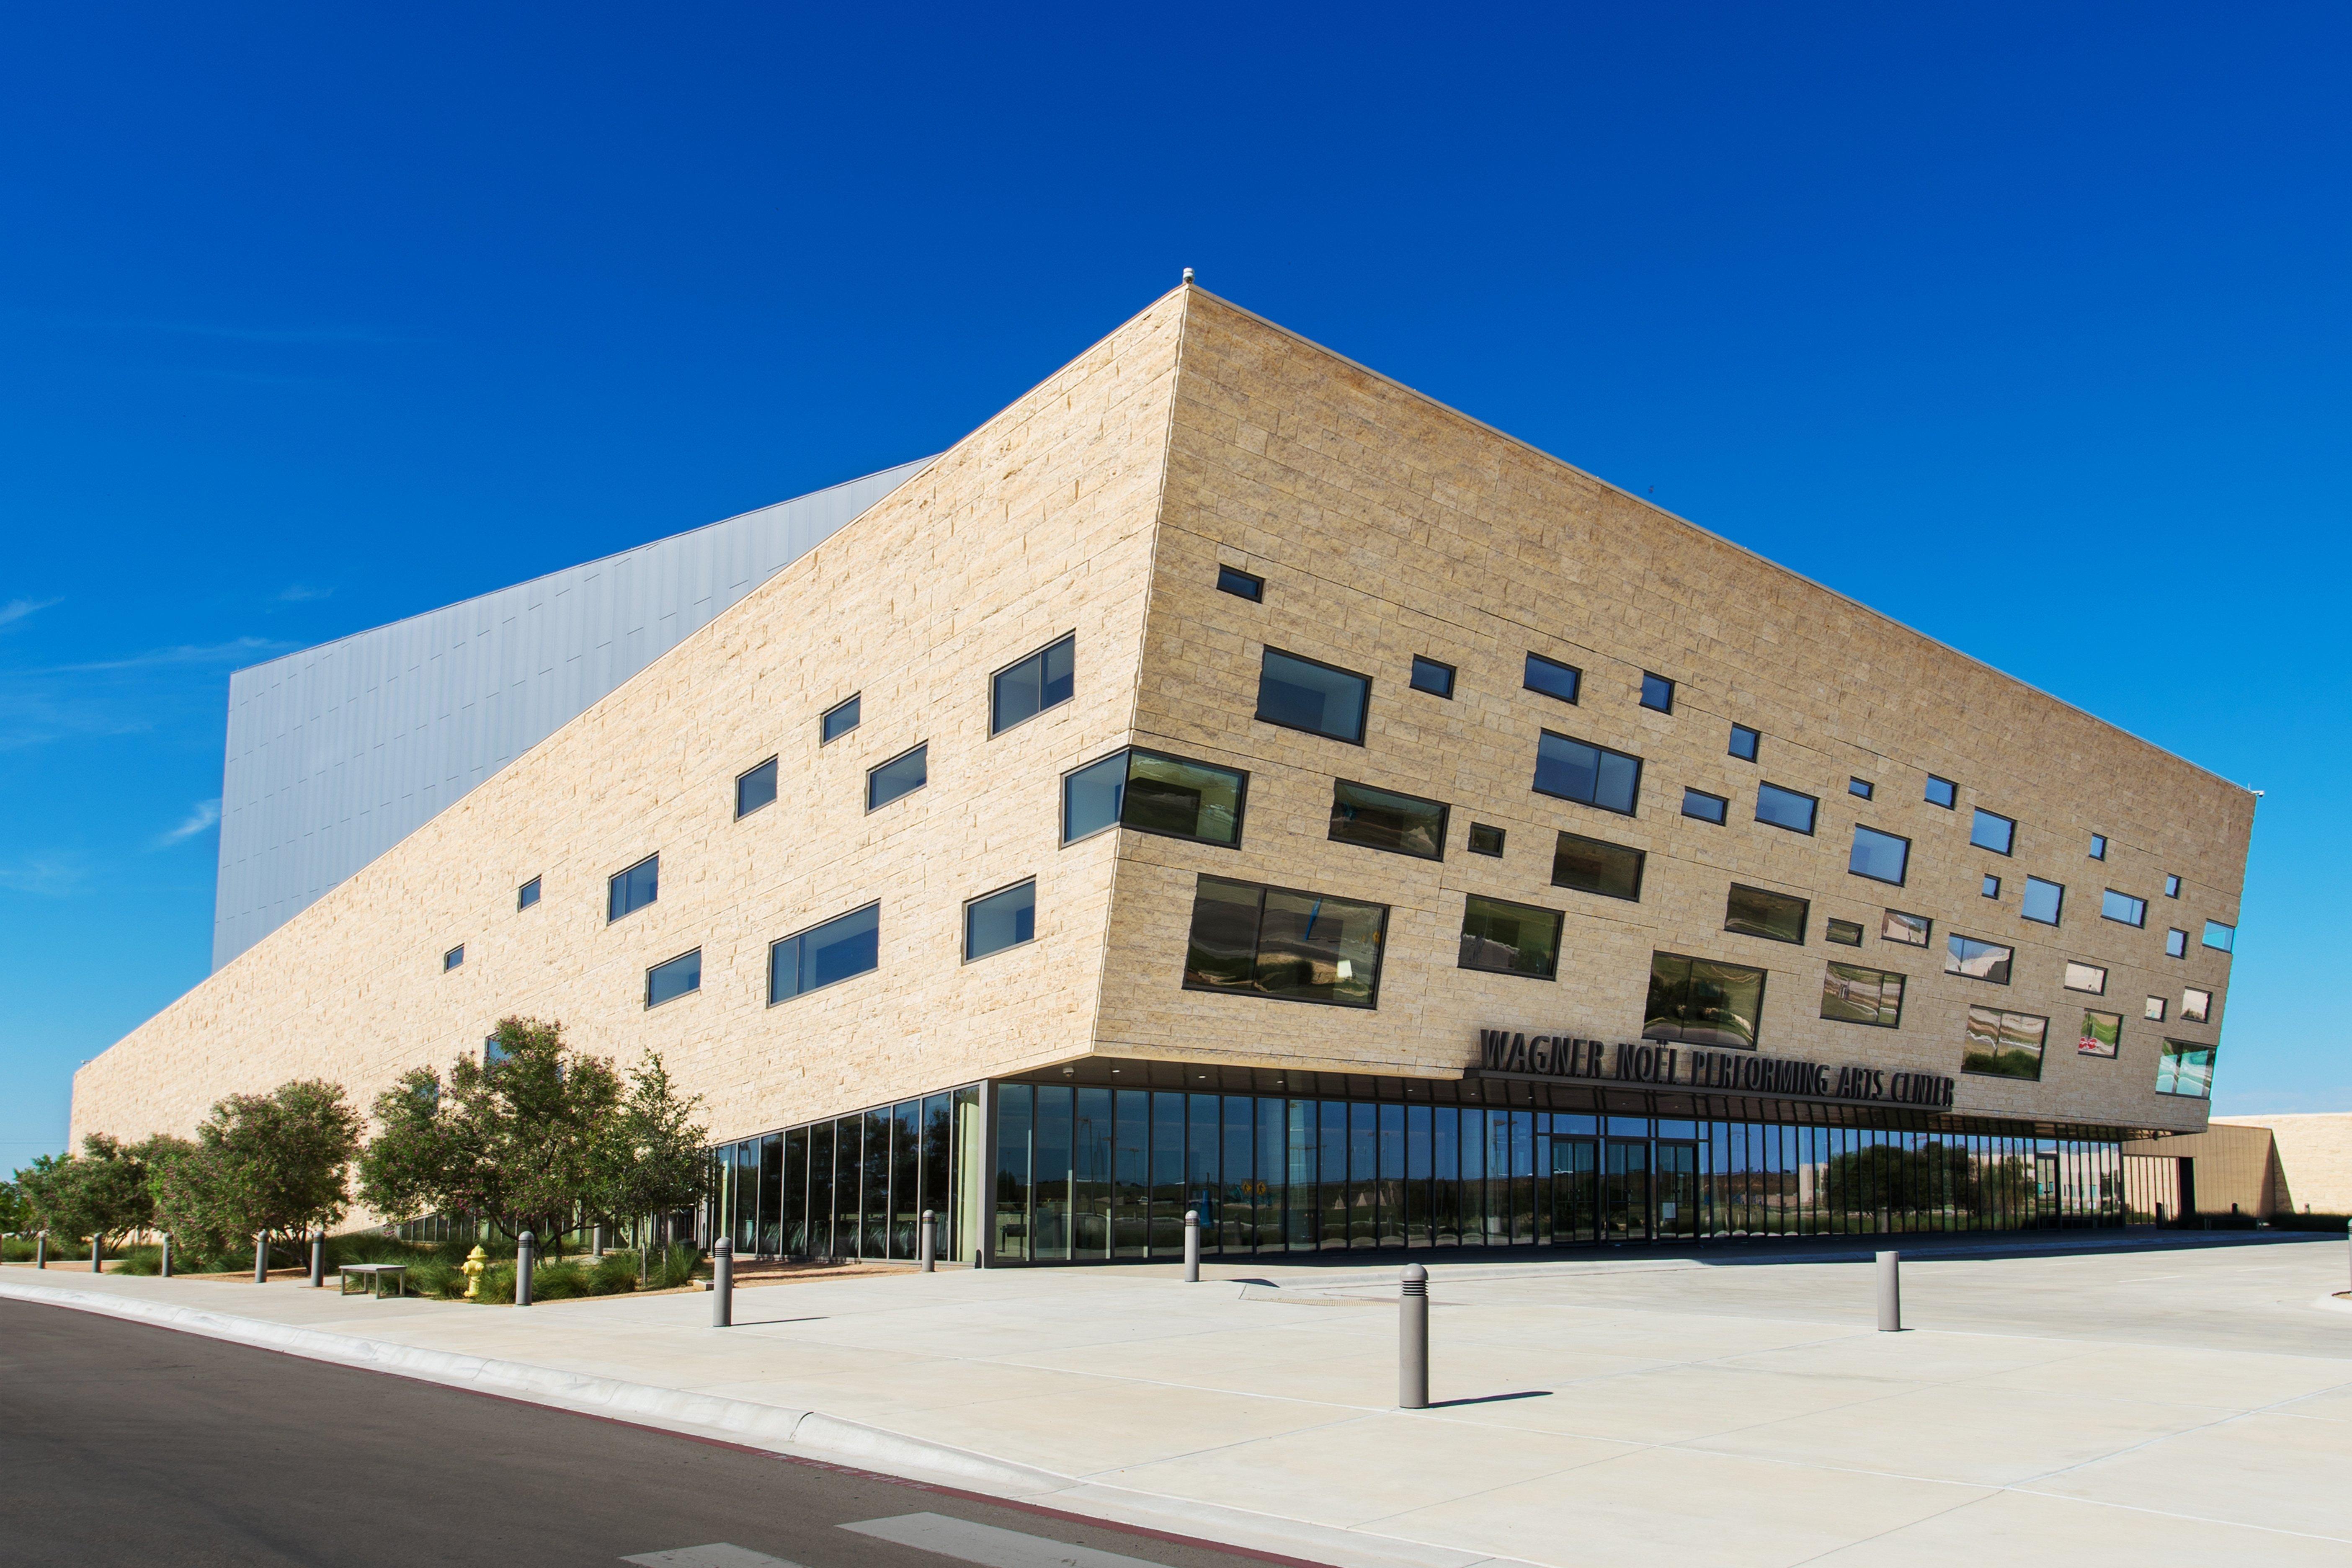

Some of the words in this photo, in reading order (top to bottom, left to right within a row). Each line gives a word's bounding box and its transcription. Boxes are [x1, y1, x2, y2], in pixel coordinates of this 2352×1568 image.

[1480, 1029, 1605, 1078] WAGNER
[1616, 1039, 1678, 1083] NOËL
[1691, 1051, 1830, 1096] PERFORMING
[1836, 1066, 1885, 1100] ARTS
[1890, 1072, 1955, 1106] CENTER
